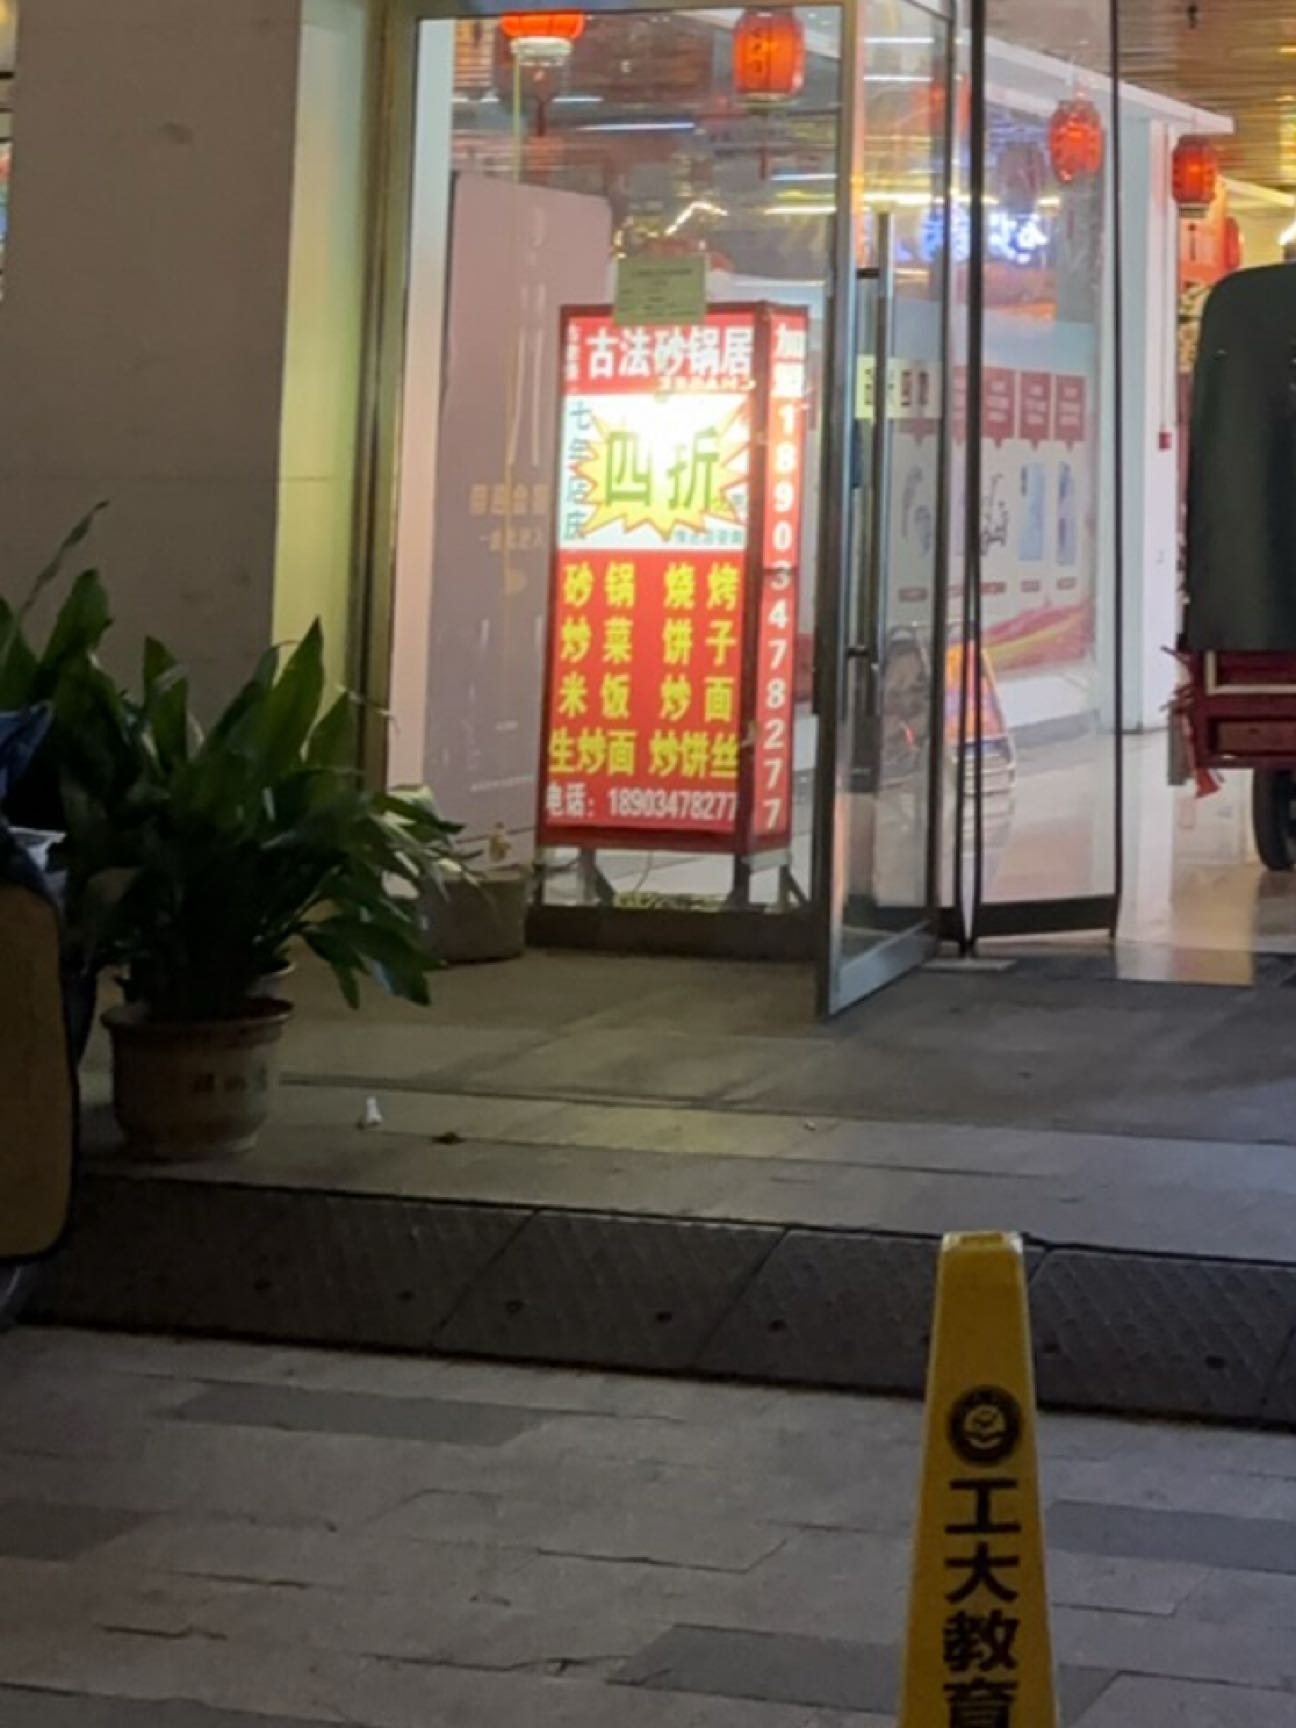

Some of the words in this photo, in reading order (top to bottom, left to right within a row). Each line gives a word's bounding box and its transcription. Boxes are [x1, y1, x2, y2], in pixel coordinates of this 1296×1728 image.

[585, 323, 755, 380] 古法砂锅居
[562, 561, 636, 608] 砂锅
[663, 561, 741, 611] 烧烤
[560, 616, 634, 664] 炒菜
[662, 618, 737, 667] 饼子
[557, 671, 630, 720] 米饭
[659, 673, 735, 723] 炒面
[548, 727, 637, 776] 生炒面
[647, 728, 739, 779] 炒饼丝
